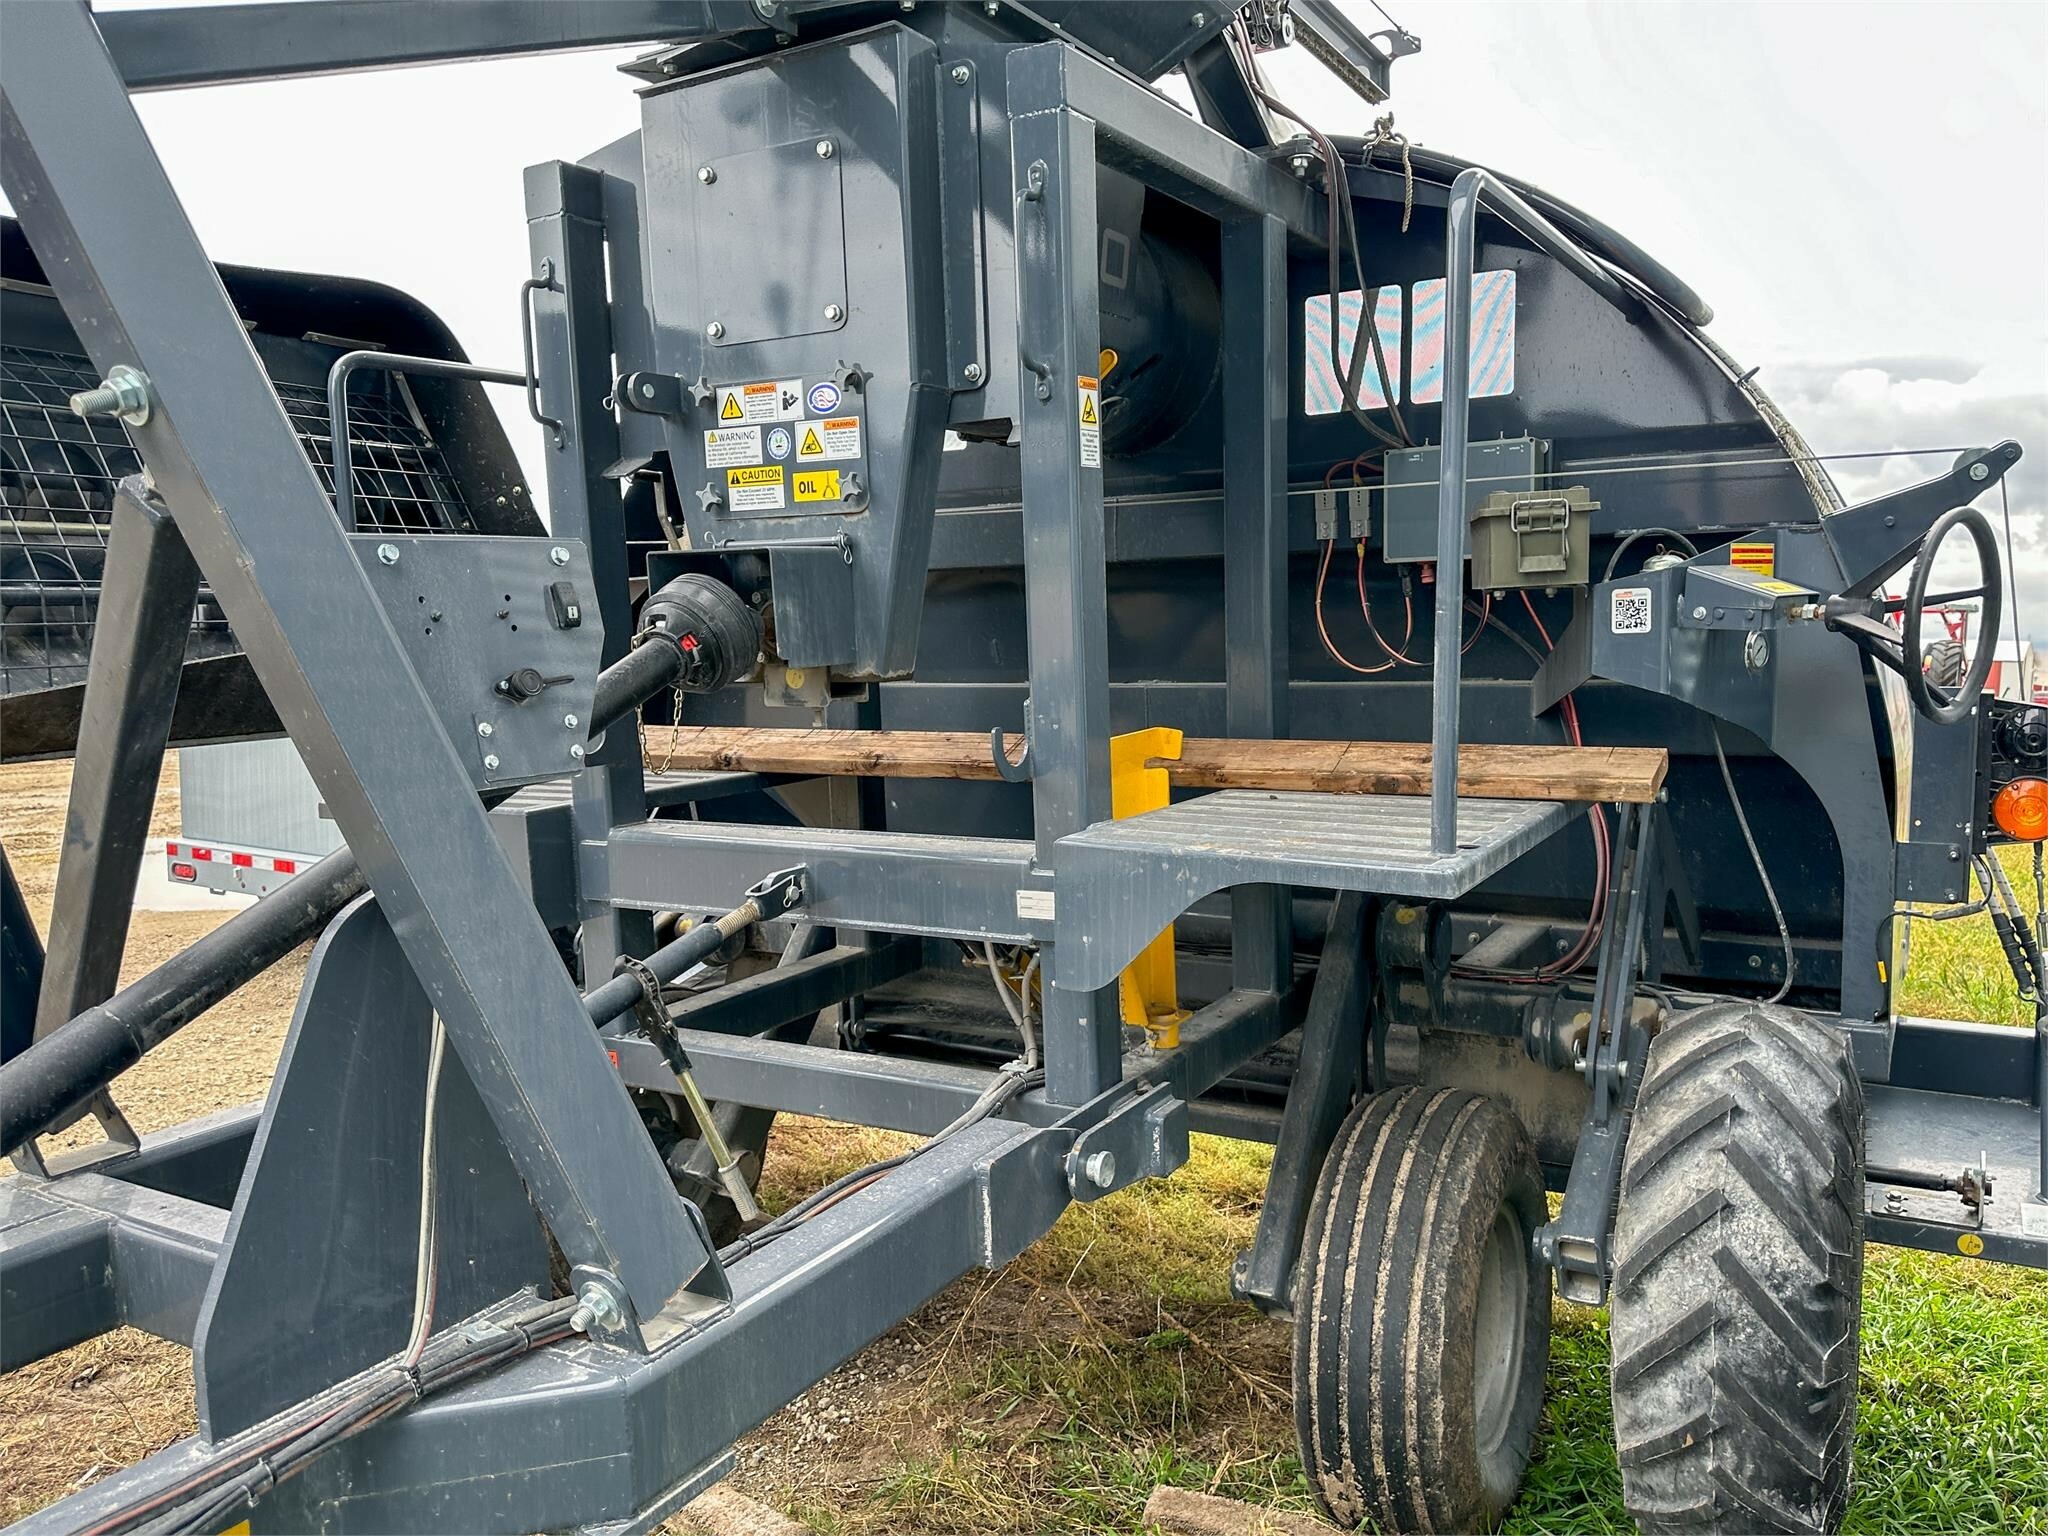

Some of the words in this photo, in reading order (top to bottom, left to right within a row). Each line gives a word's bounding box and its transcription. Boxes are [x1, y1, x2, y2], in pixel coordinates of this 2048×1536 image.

[751, 385, 775, 393] WARNING
[831, 421, 857, 429] WARNING
[741, 469, 780, 480] CAUTION
[798, 481, 817, 494] OIL
